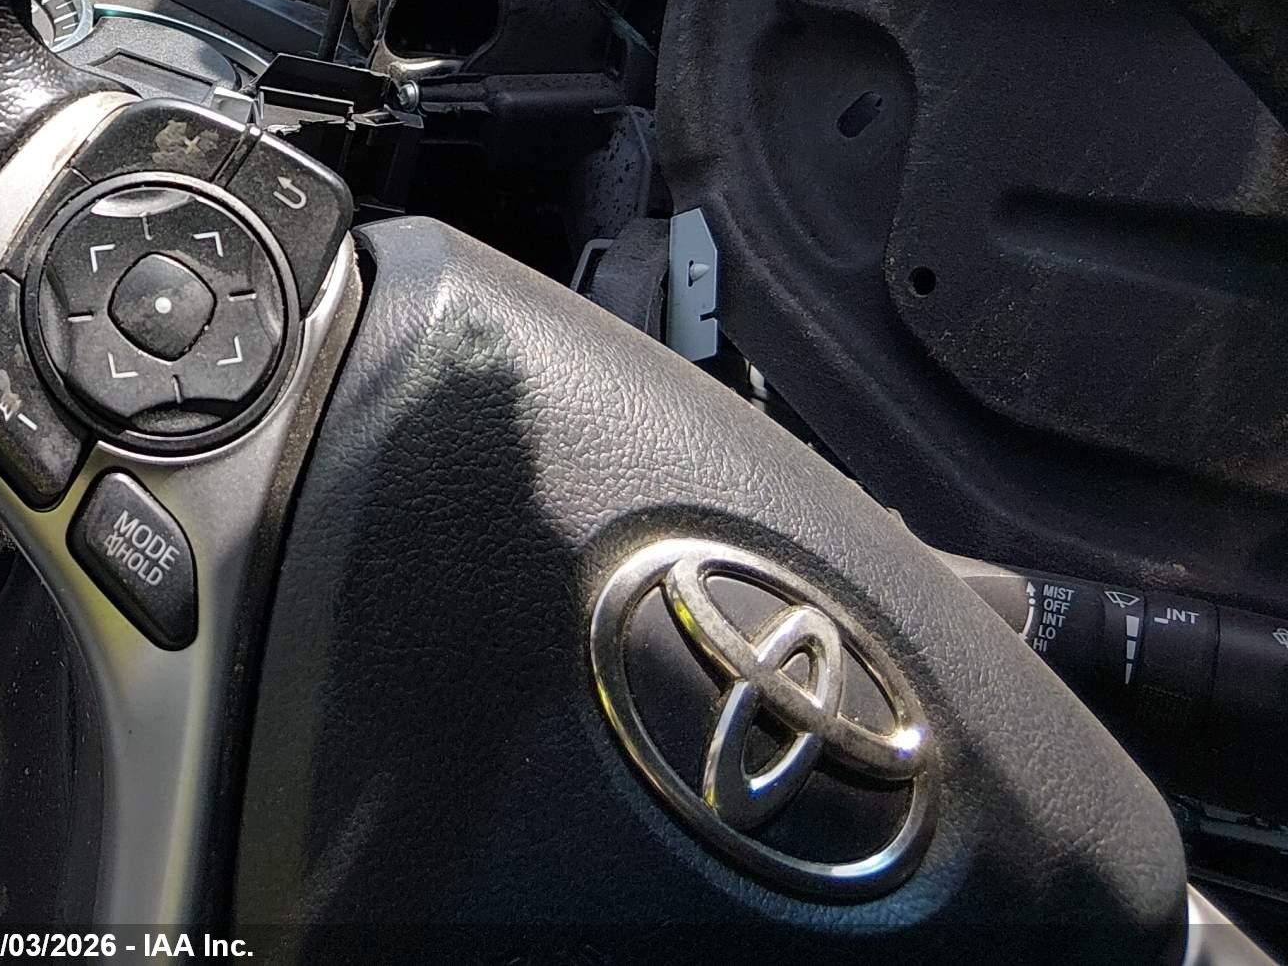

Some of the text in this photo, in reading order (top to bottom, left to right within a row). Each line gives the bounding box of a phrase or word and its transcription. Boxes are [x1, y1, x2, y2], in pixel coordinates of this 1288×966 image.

[113, 509, 181, 571] MODE
[115, 542, 164, 586] HOLD
[1043, 584, 1075, 601] MIST
[1043, 598, 1071, 614] OFF
[1042, 611, 1066, 628] INT
[1166, 607, 1200, 625] INT
[1038, 624, 1056, 640] LO
[1032, 637, 1048, 652] HI
